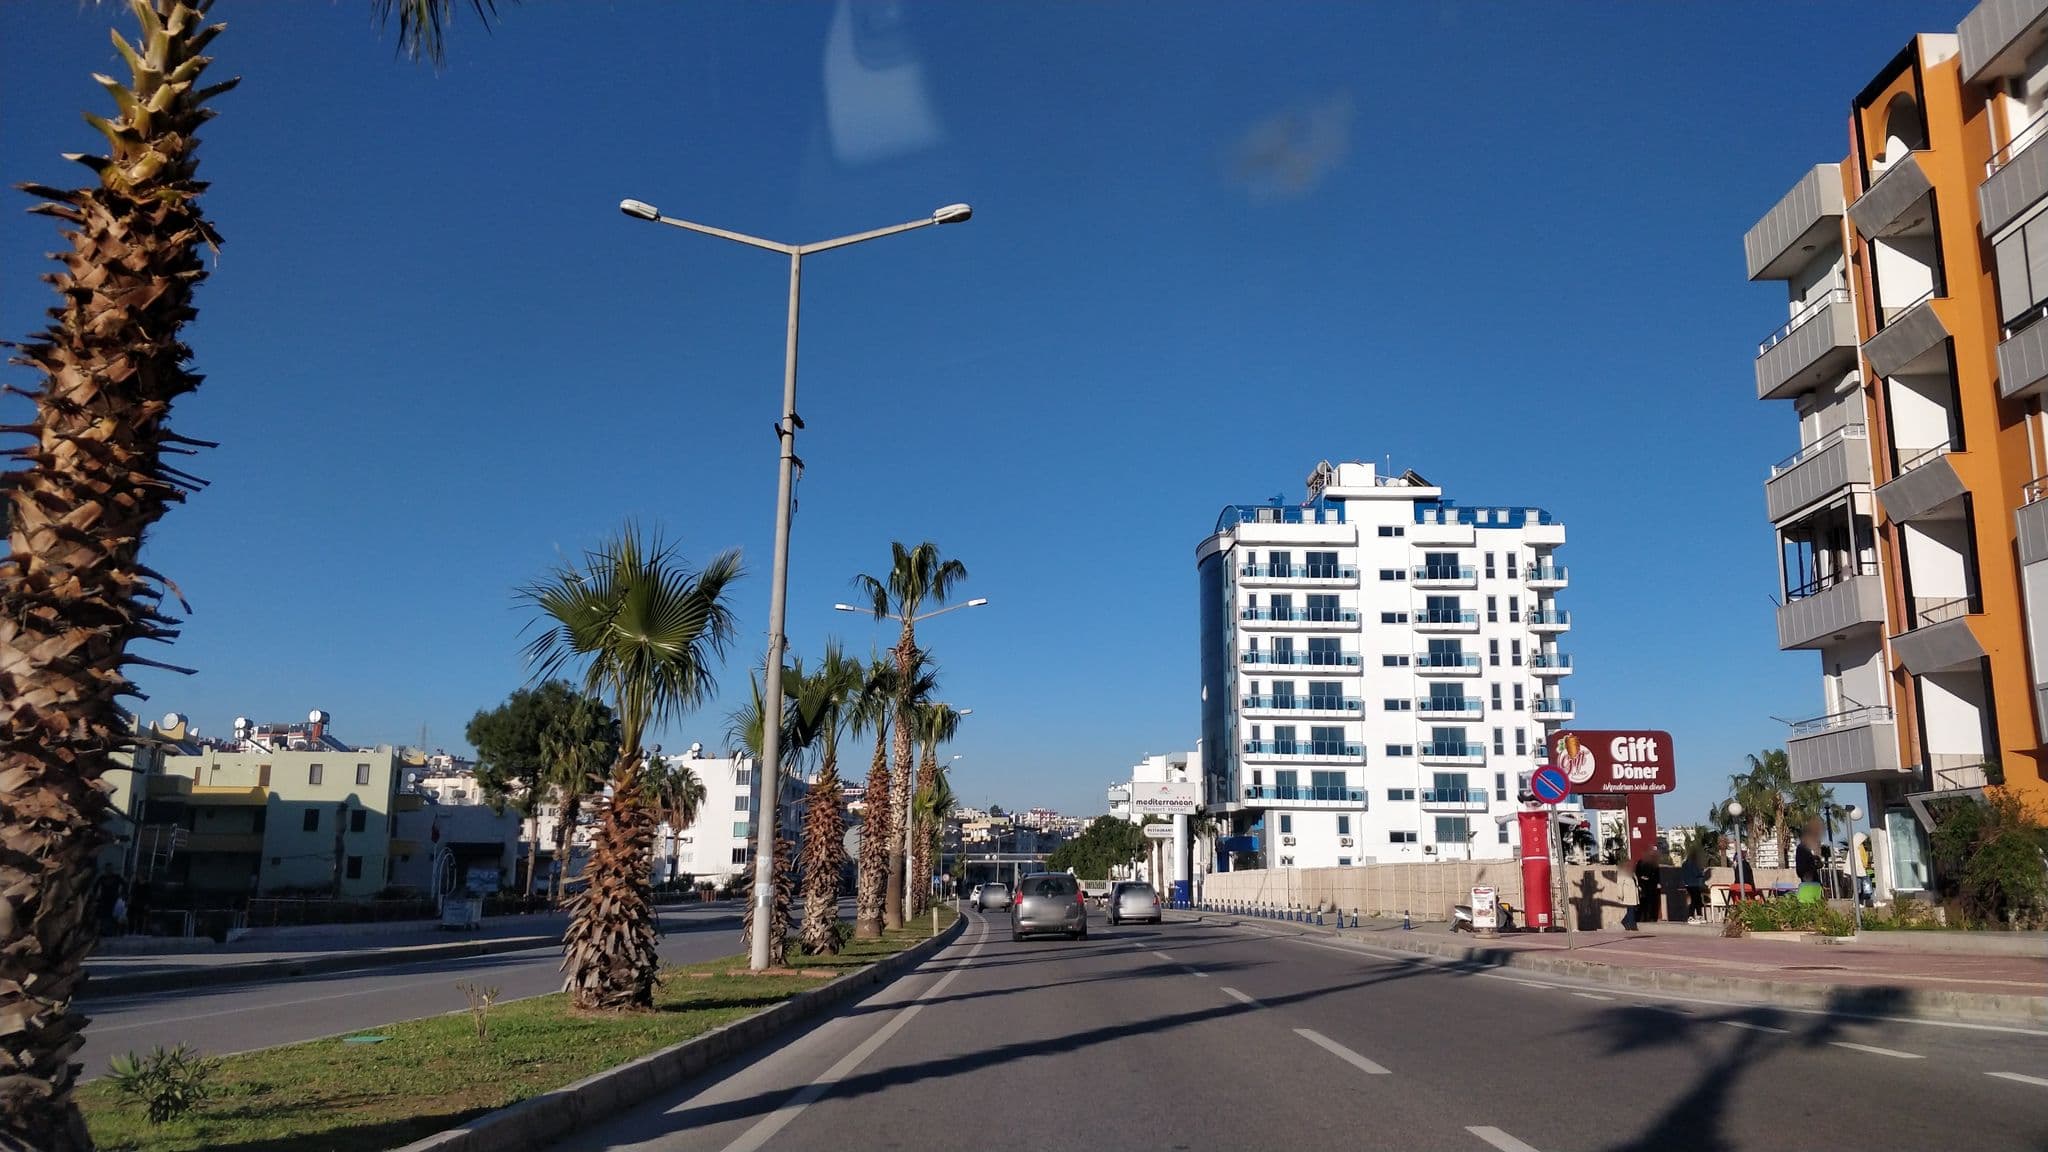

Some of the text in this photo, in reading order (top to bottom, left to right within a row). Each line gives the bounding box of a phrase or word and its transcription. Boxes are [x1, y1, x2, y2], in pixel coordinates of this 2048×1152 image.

[1610, 736, 1658, 762] Gift
[1612, 763, 1659, 779] Döner
[1136, 798, 1193, 806] mediterranean
